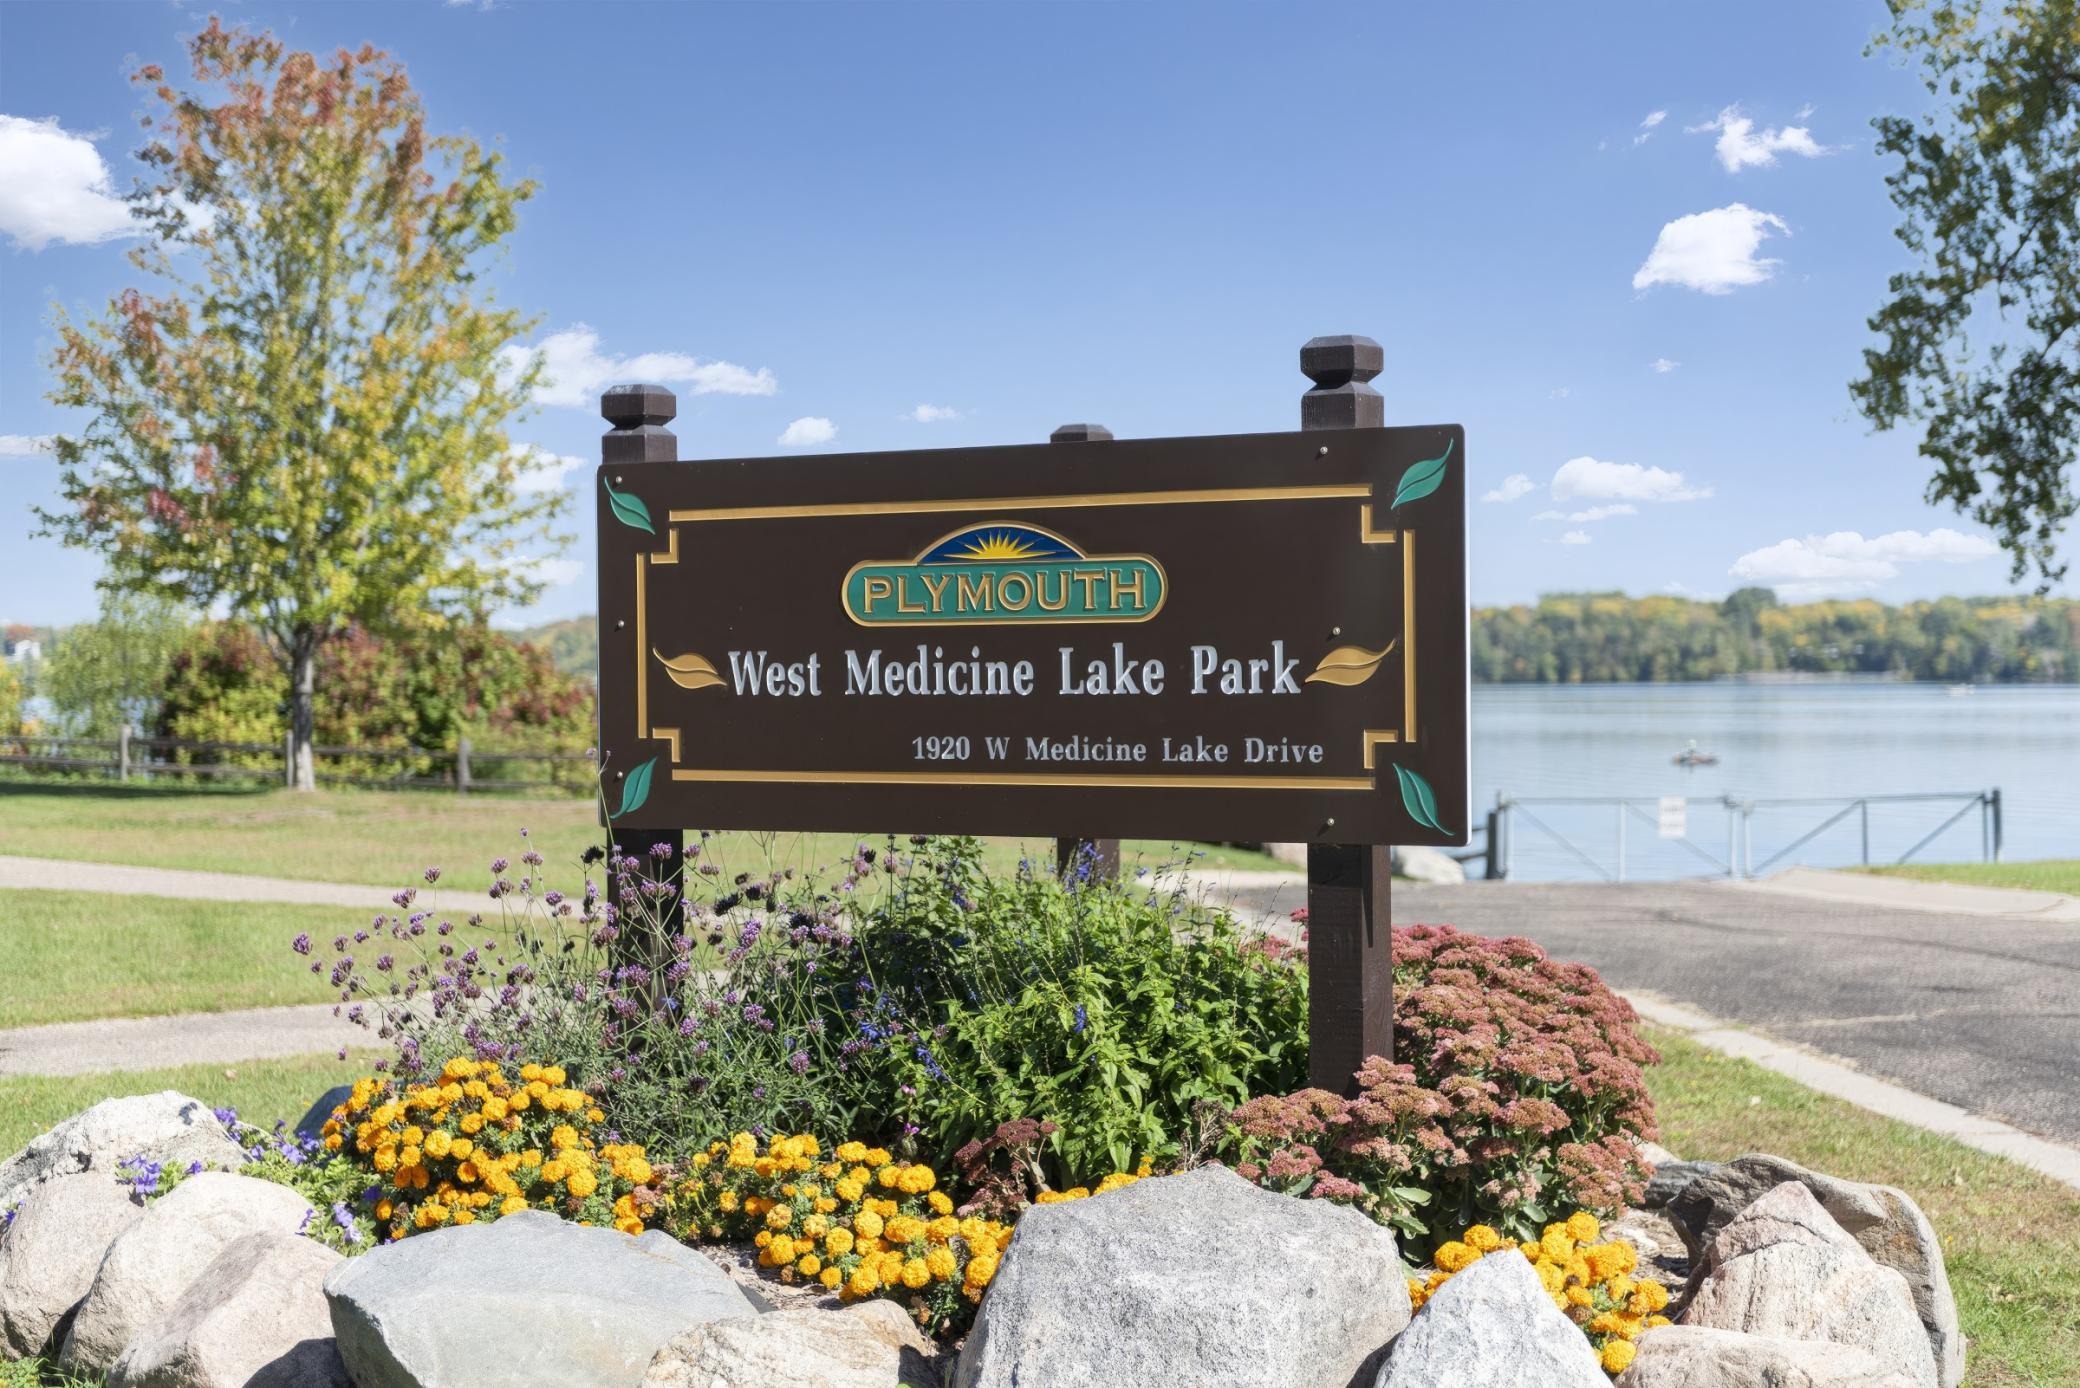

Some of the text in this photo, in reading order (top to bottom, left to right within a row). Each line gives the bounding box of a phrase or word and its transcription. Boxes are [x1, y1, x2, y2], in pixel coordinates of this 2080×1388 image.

[863, 570, 1145, 614] PLYMOUTH
[727, 639, 1302, 697] West Medicine Lake Park
[912, 735, 1324, 763] 1920 W Medicine Lake Drive
